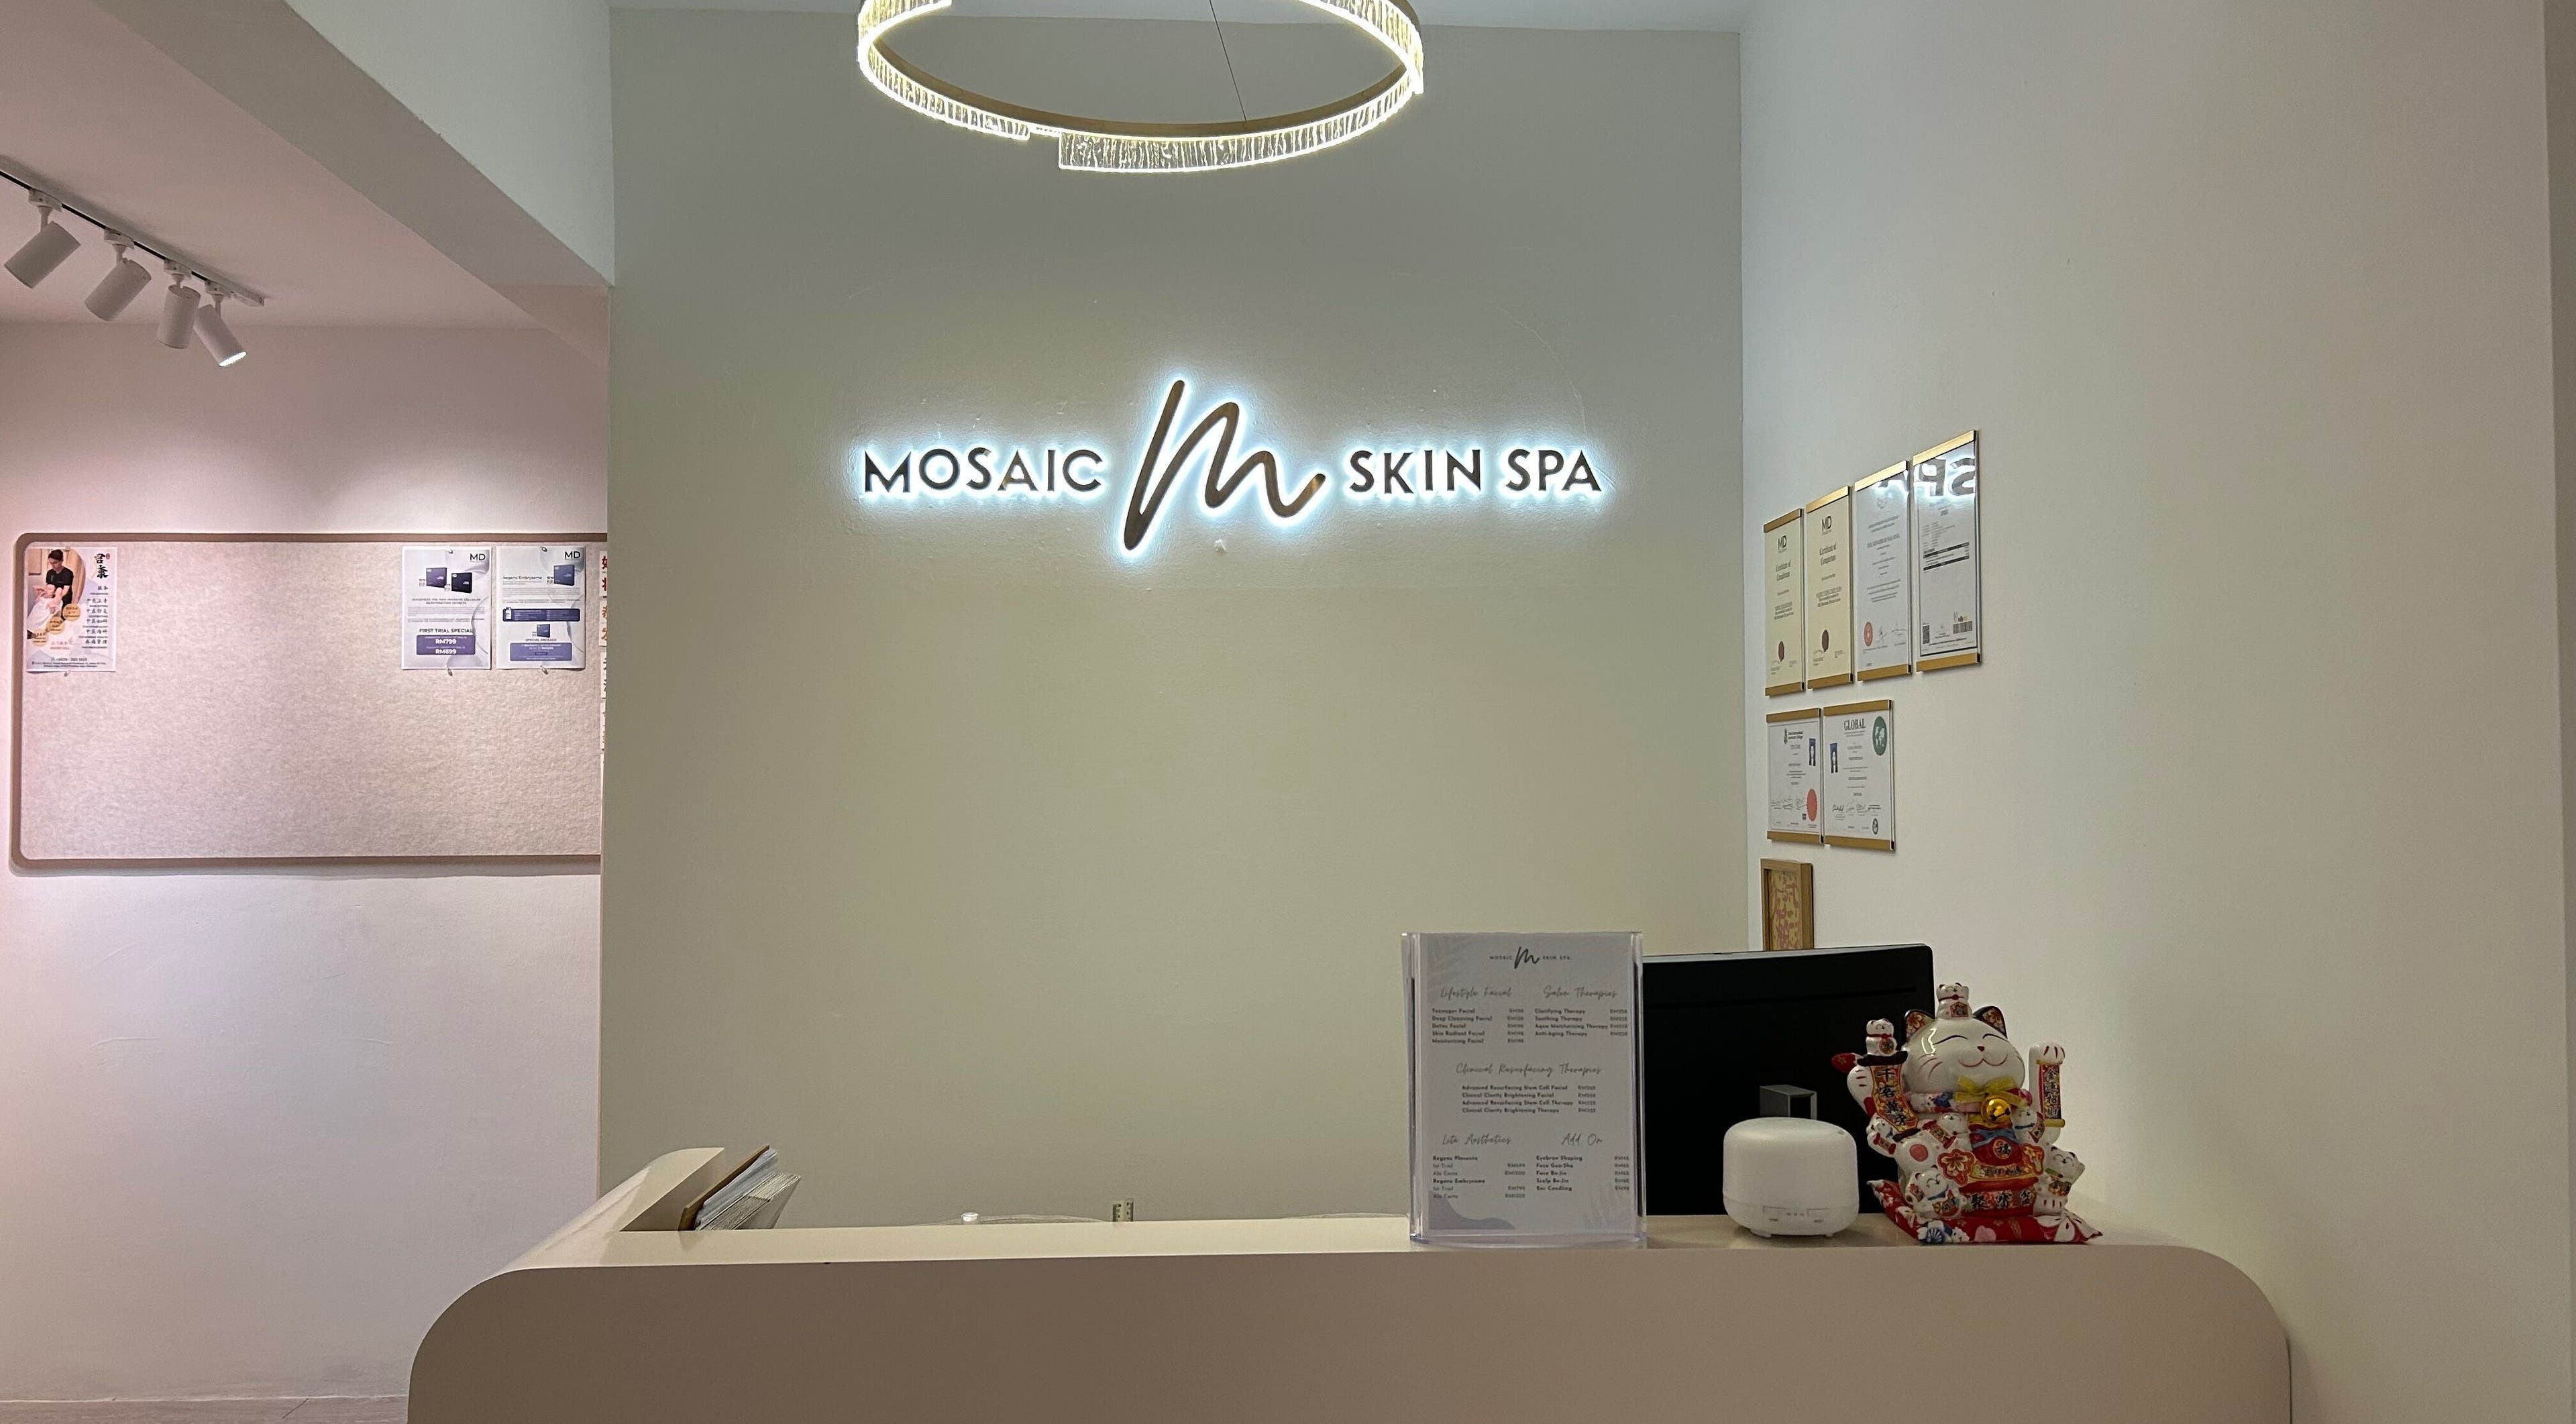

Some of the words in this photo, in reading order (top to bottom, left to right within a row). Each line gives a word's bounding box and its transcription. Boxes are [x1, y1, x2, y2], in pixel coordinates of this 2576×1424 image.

[864, 447, 1104, 493] MOSAIC
[1349, 449, 1481, 494] SKIN
[1505, 448, 1603, 492] SPA
[1822, 515, 1832, 532] MD
[1778, 535, 1787, 550] MD
[565, 551, 580, 559] MD
[1843, 718, 1866, 731] GLOBAL
[1440, 986, 1479, 1001] Lifestyle
[1483, 987, 1512, 997] Facial
[1543, 986, 1569, 998] Salon
[1574, 987, 1617, 1001] Therapies
[1456, 1062, 1493, 1075] Clinical
[1499, 1062, 1554, 1079] Resurfacing
[1559, 1062, 1602, 1077] Therapies
[1464, 1134, 1512, 1145] Aesthetics
[1562, 1133, 1582, 1146] Add
[1587, 1134, 1603, 1146] On
